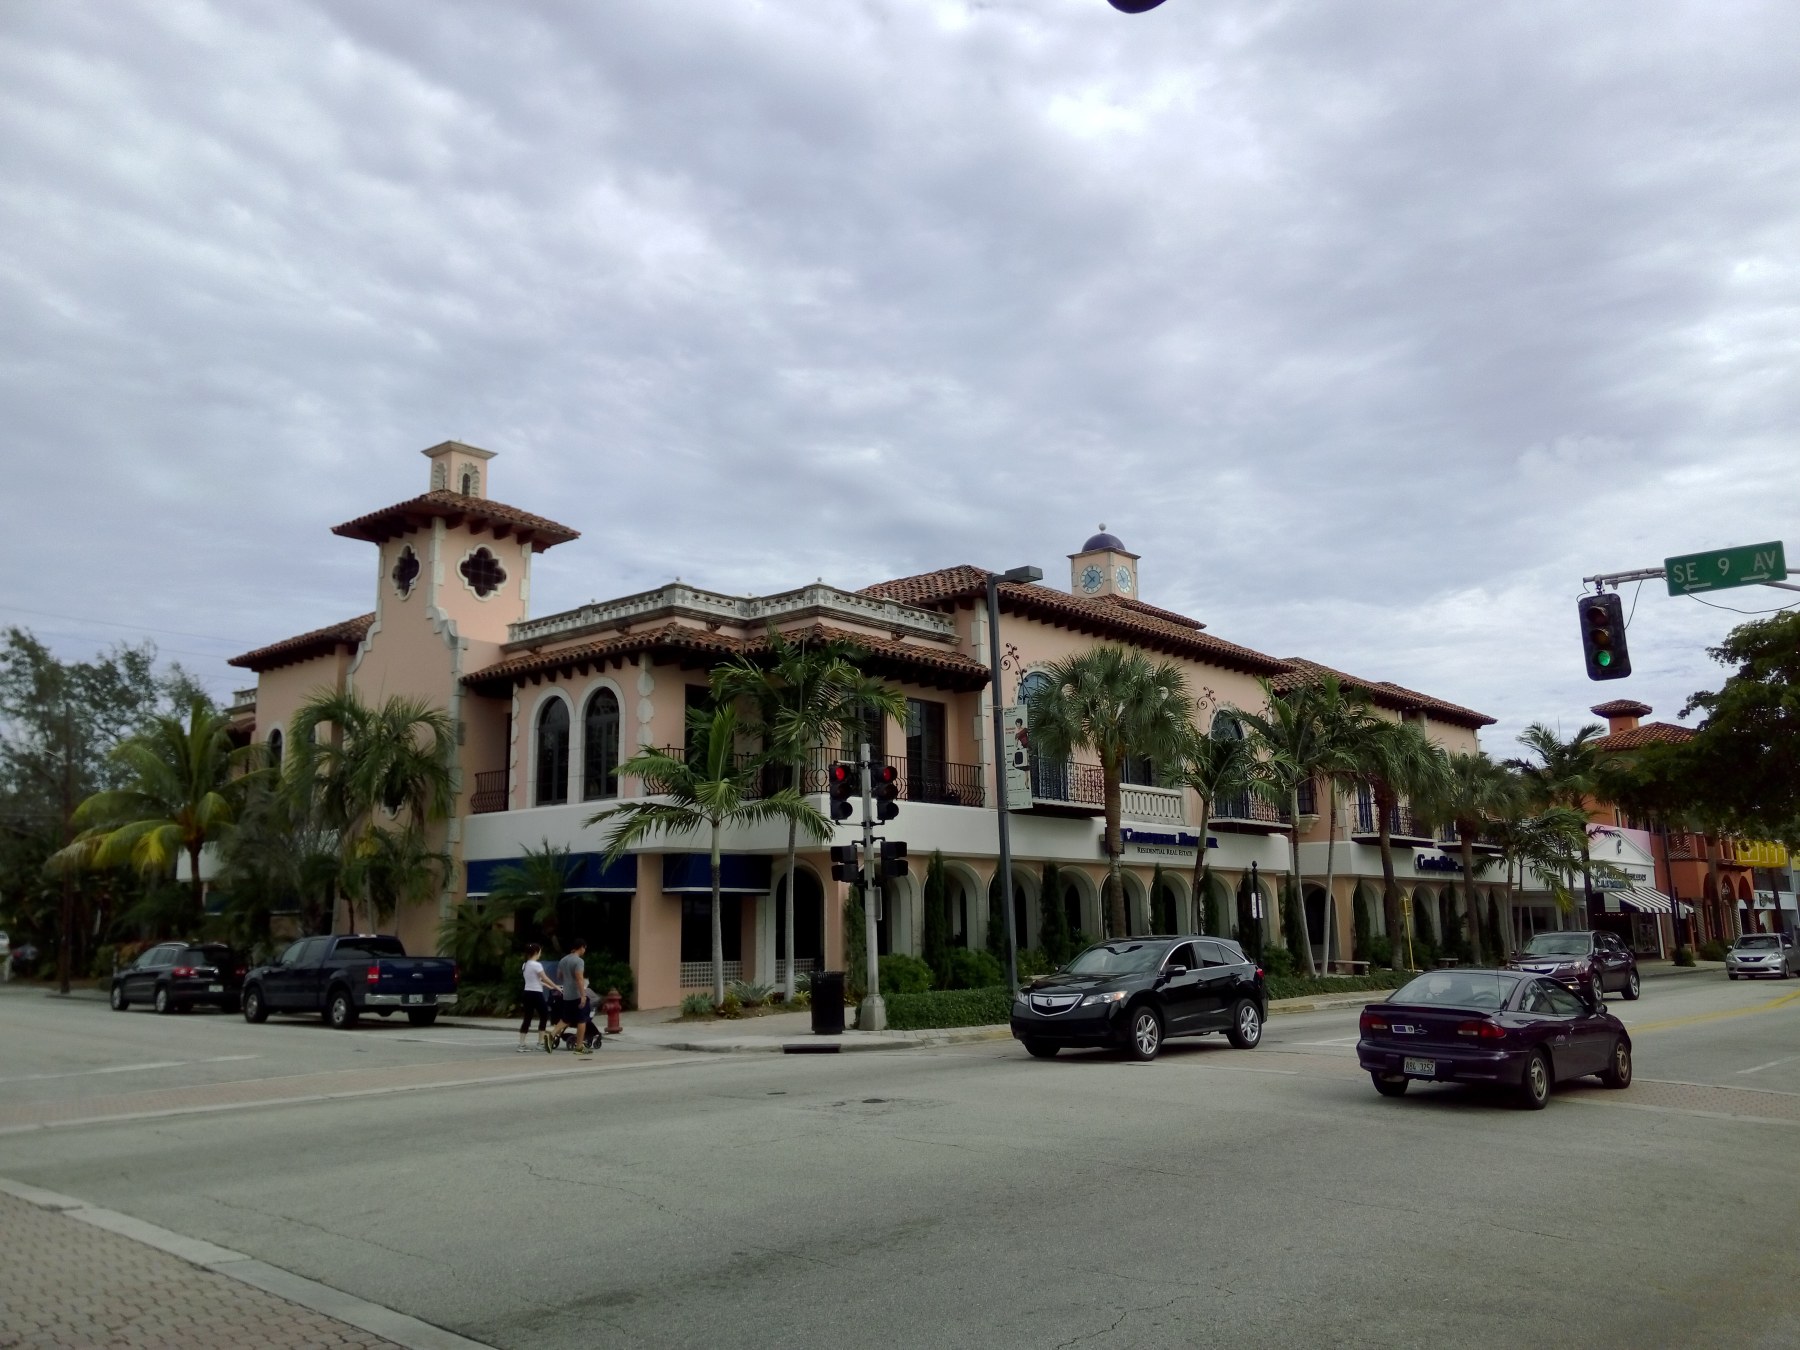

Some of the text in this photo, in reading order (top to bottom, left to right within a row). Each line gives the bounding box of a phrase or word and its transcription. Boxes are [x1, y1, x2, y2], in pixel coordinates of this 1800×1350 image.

[1673, 550, 1776, 583] SE 9 AV
[1137, 846, 1193, 857] RESIDENTIAL REAL ESTATE
